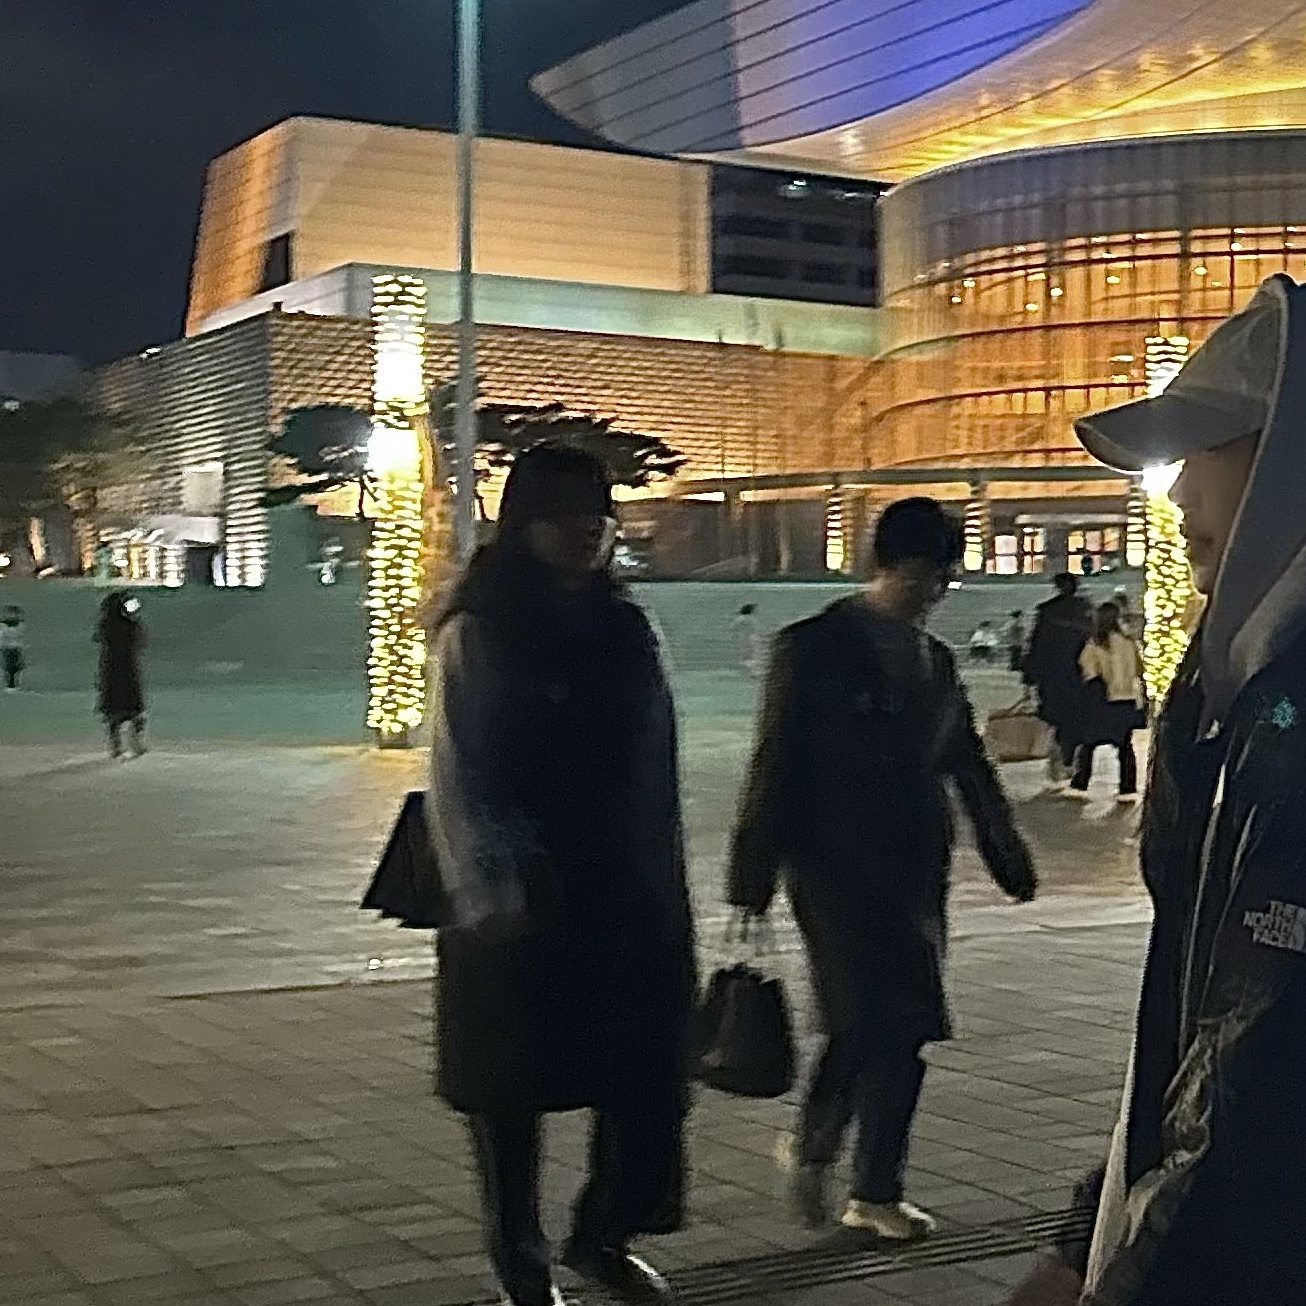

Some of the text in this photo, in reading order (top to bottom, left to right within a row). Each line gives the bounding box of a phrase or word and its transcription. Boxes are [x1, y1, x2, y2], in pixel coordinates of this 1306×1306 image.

[1267, 900, 1298, 918] THE
[1243, 911, 1294, 933] NORTH
[1252, 928, 1289, 948] FACE
